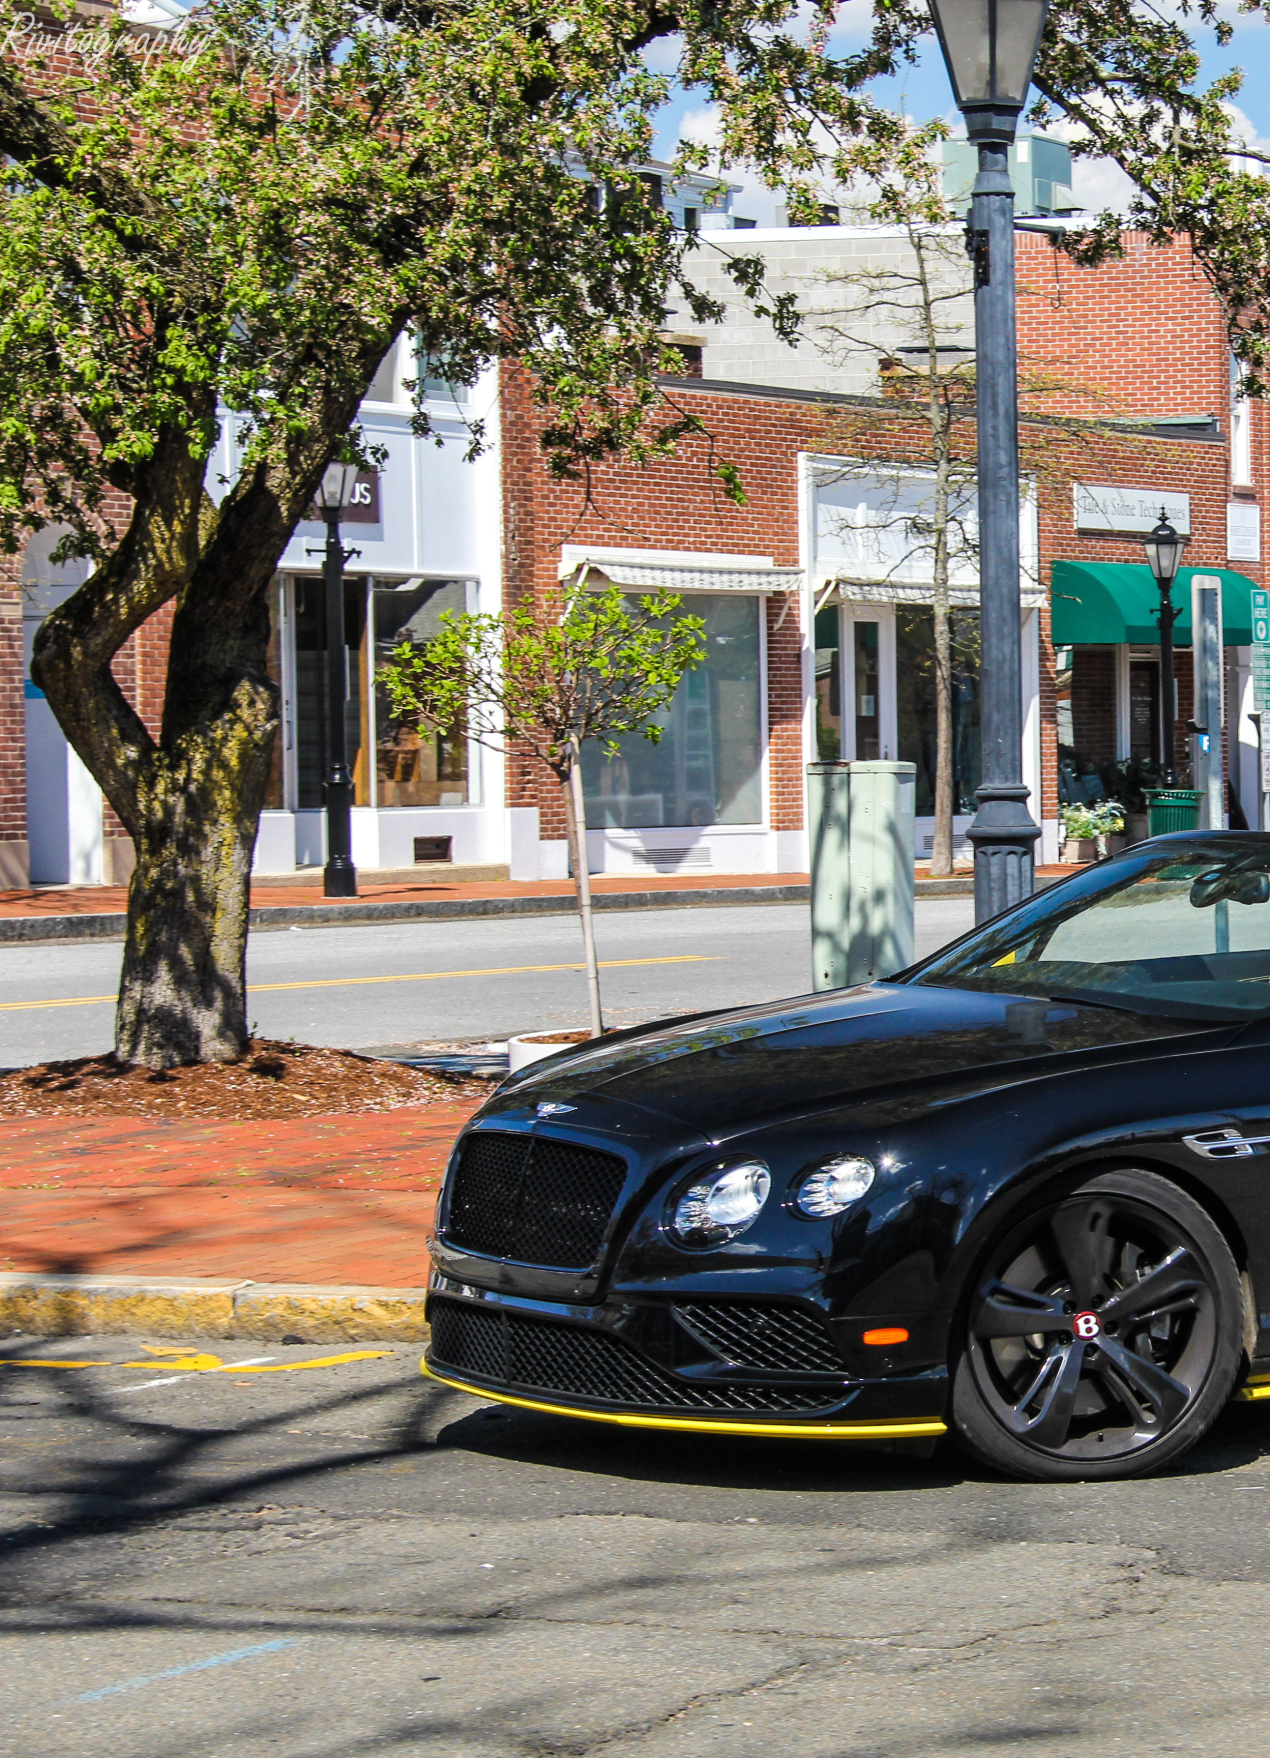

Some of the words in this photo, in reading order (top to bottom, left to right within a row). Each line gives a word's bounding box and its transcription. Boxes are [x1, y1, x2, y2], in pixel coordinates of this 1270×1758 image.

[1081, 495, 1099, 514] Tile
[1102, 498, 1109, 514] &
[1111, 497, 1136, 517] Stone
[1076, 1314, 1100, 1337] B
